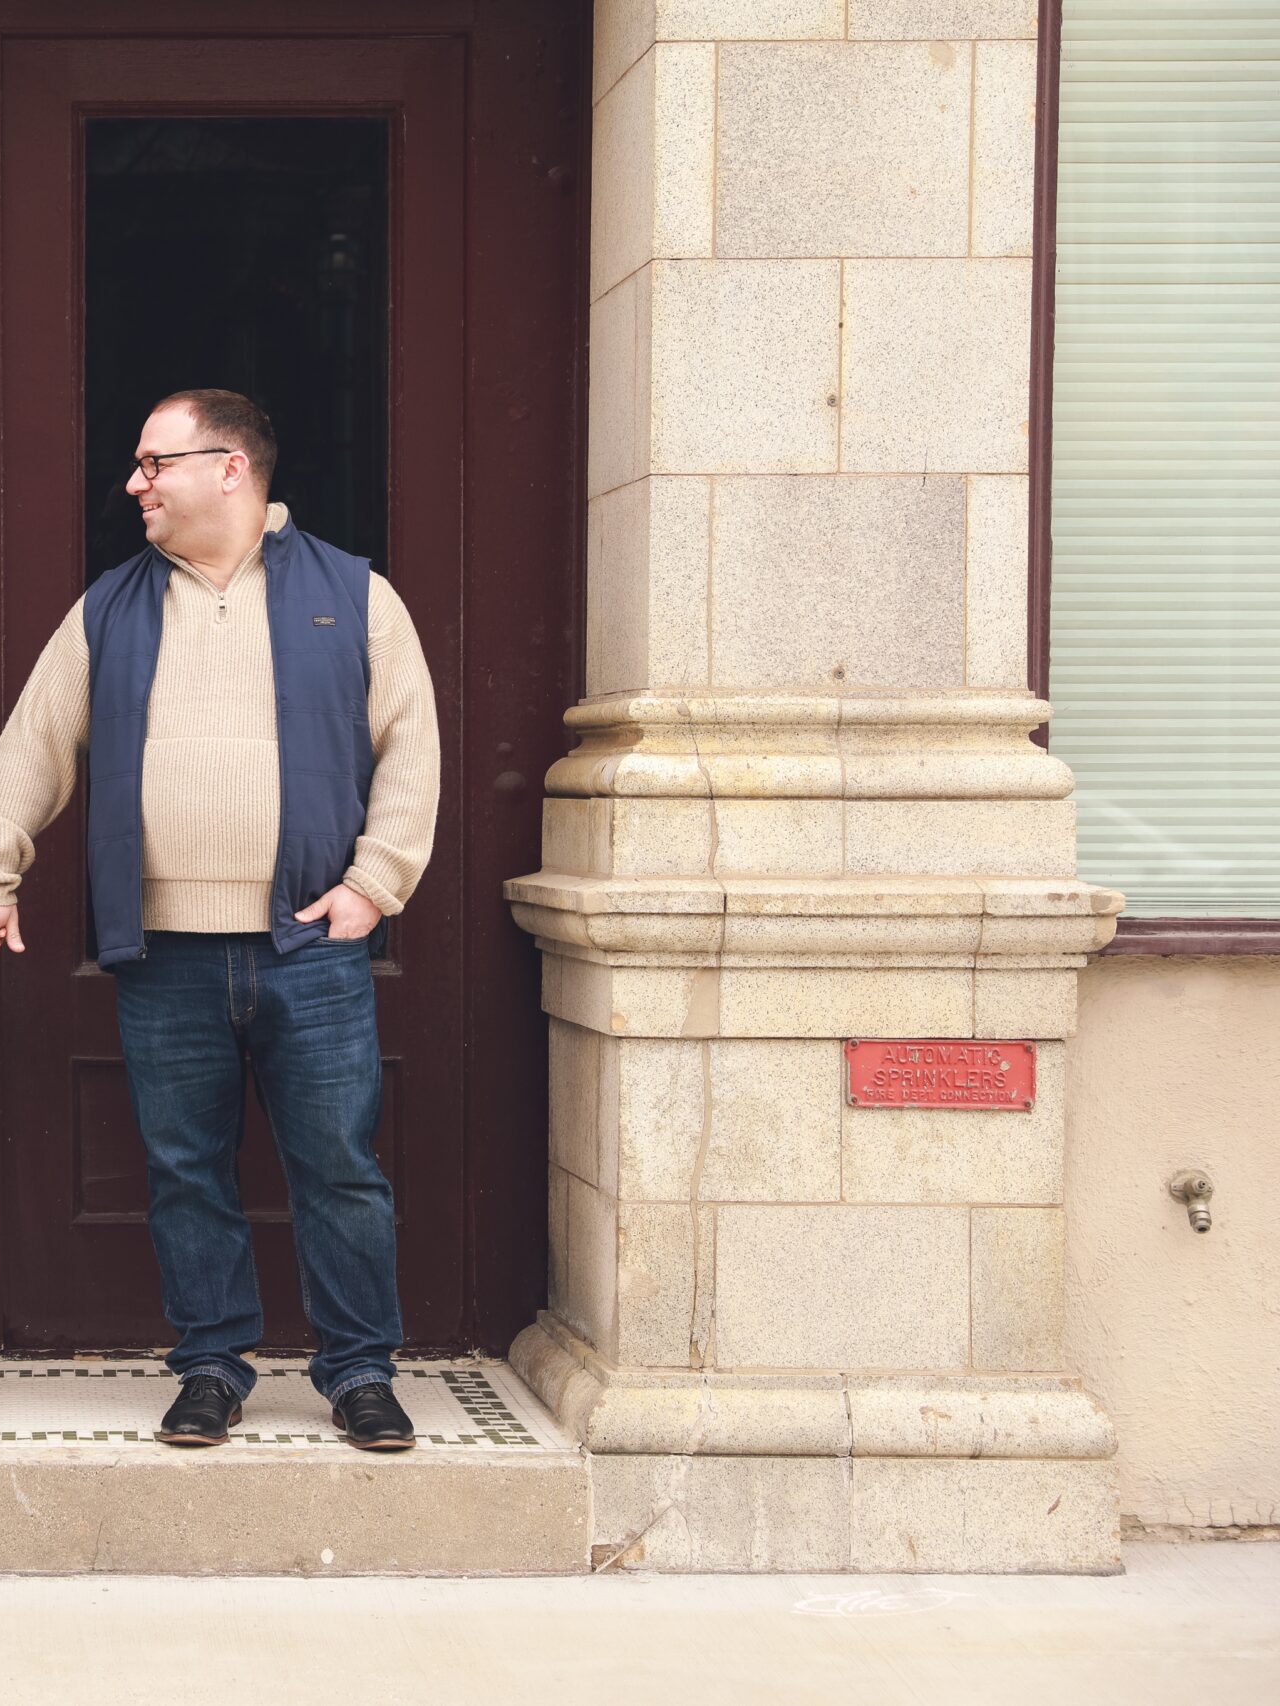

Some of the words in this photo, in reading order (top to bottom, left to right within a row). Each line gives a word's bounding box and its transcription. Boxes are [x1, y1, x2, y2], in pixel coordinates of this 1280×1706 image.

[882, 1046, 1001, 1066] AUTOMATIC
[873, 1068, 1007, 1088] SPRINKLERS
[866, 1088, 895, 1100] FIRE
[939, 1089, 1015, 1102] CONNECTION
